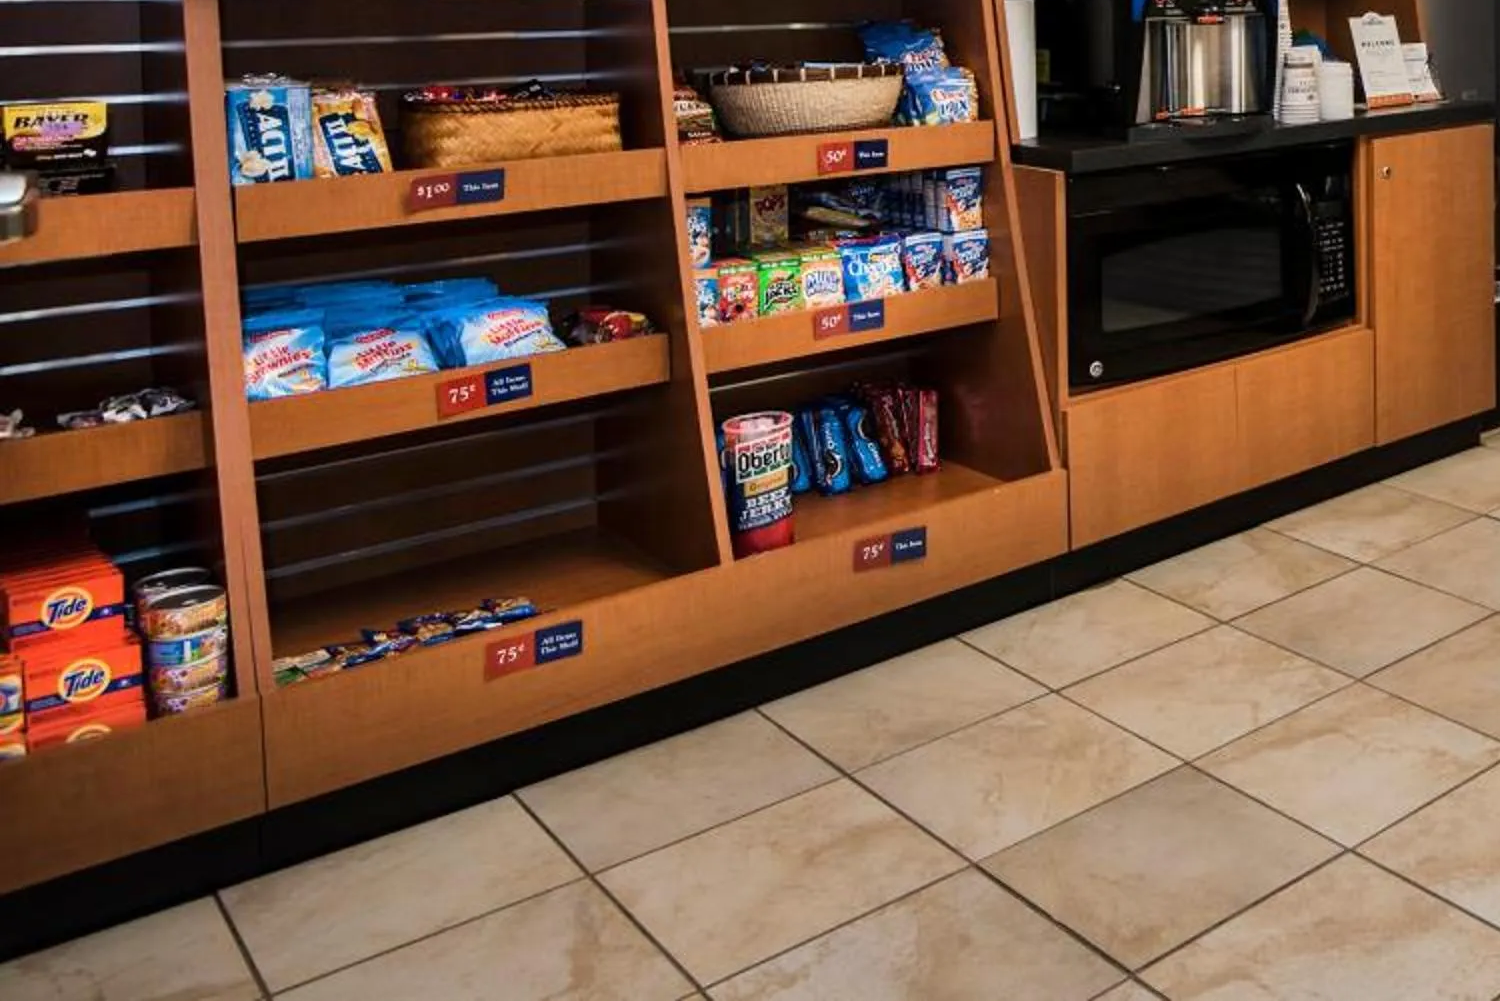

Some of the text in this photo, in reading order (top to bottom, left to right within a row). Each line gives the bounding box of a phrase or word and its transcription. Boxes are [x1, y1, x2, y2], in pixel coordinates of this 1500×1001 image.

[14, 112, 89, 130] BAYER
[746, 486, 790, 509] BEEF
[48, 598, 87, 624] Tide
[64, 669, 106, 697] Tide
